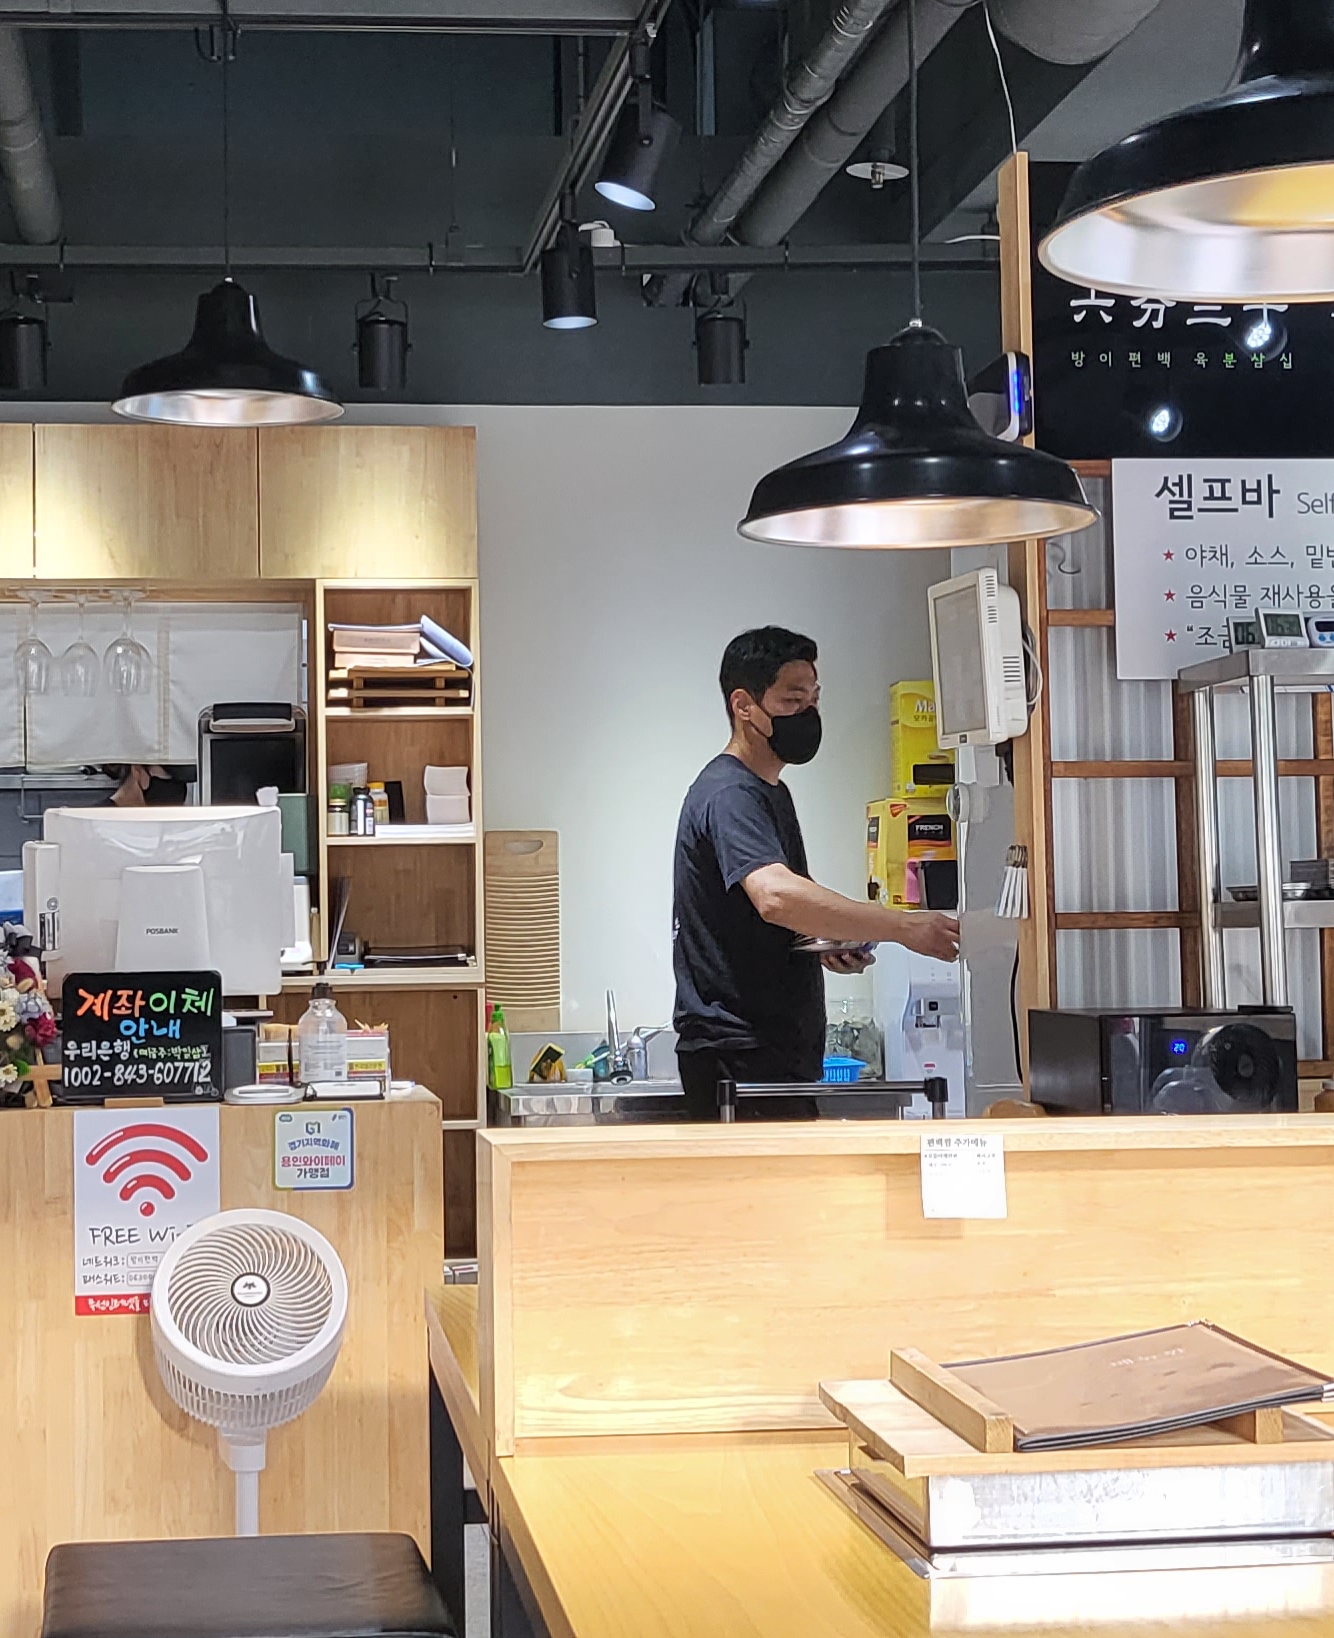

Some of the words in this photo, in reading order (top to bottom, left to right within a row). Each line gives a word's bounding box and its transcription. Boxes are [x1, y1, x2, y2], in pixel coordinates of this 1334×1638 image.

[1155, 473, 1281, 521] 셀프바
[1185, 544, 1236, 569] 야채,
[1245, 545, 1295, 569] 소스,
[1185, 584, 1252, 610] 음식물
[915, 699, 935, 713] Ma
[76, 987, 215, 1021] 계좌이체
[119, 1017, 181, 1044] 안내
[63, 1039, 131, 1061] 우리은행
[296, 1167, 330, 1179] 가맹점
[88, 1226, 142, 1247] FREE
